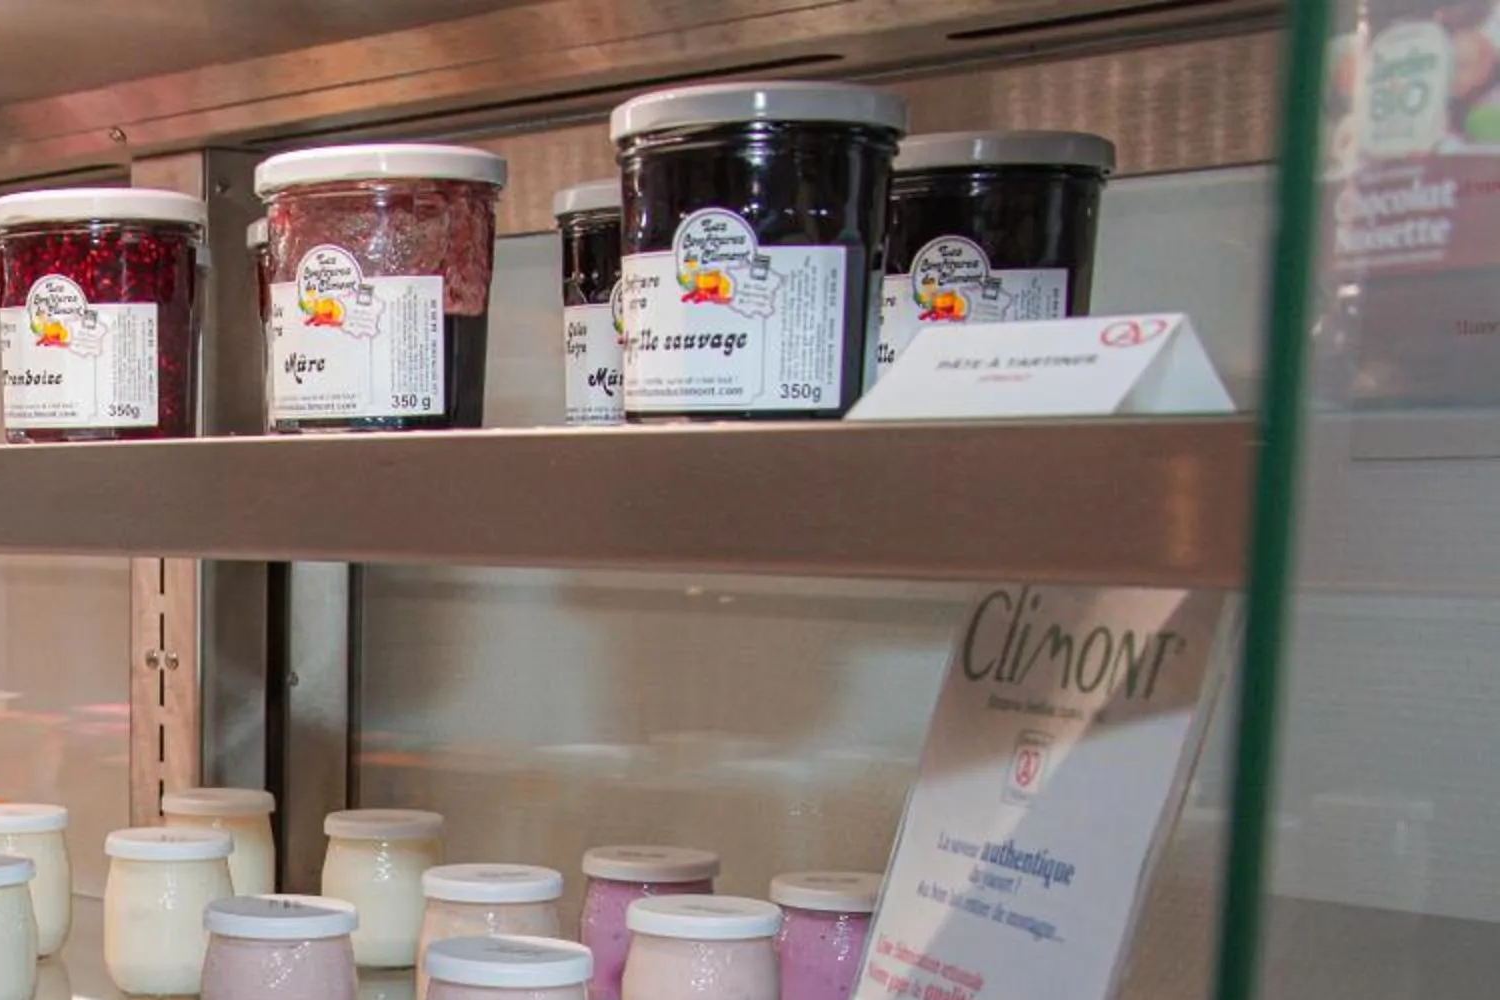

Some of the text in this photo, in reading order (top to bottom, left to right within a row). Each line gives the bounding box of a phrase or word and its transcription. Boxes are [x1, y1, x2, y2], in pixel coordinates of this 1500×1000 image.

[663, 332, 748, 357] sauvage
[587, 366, 624, 397] Mûr
[779, 382, 823, 404] 350g
[108, 403, 142, 420] 350g
[390, 393, 432, 411] 350 g
[980, 839, 1076, 889] authentique
